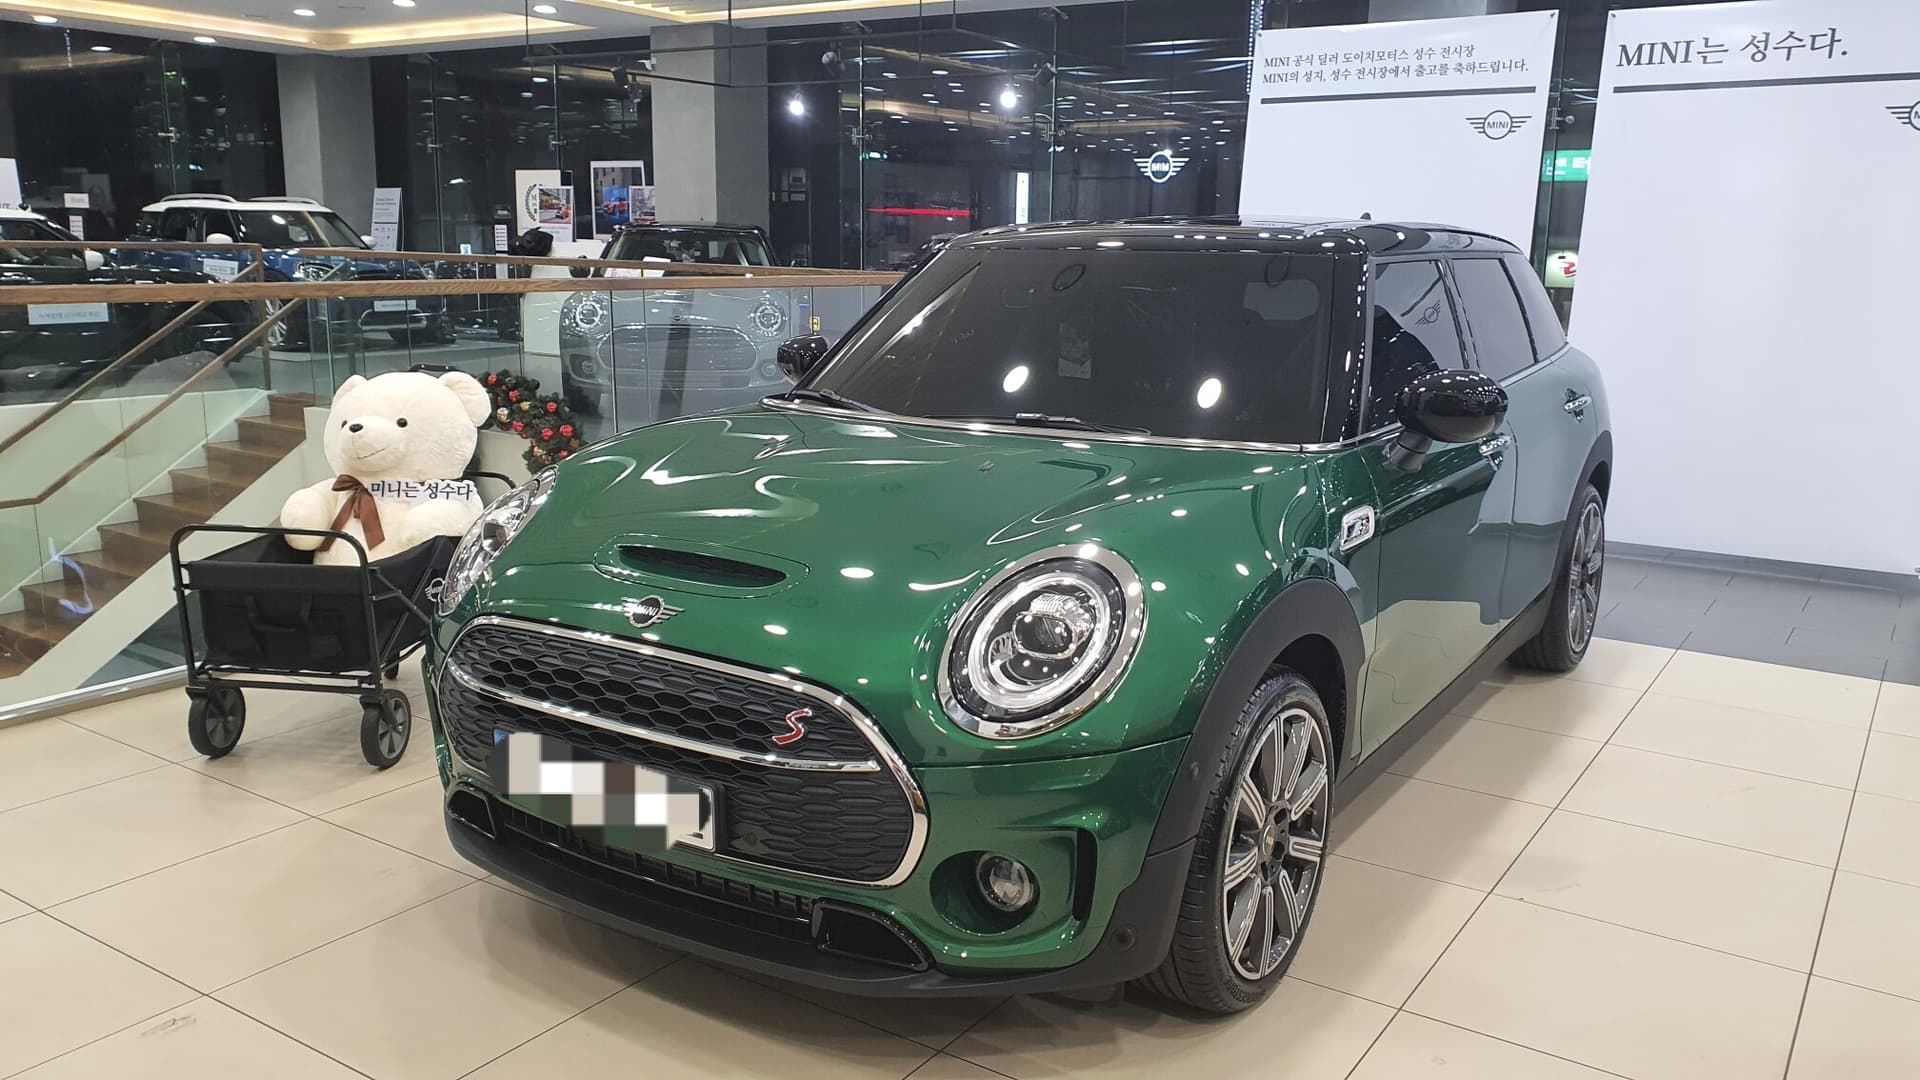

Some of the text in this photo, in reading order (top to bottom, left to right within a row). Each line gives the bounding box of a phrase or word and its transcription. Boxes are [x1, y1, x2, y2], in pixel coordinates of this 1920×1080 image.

[1264, 44, 1475, 68] MINI 공식 딜러 도이치모터스 성수 전시장
[1616, 27, 1848, 67] MINI는 성수다.
[1262, 58, 1529, 84] MINI의 성지, 성수 전시장에서 출고를 축하드립니다.
[1486, 121, 1509, 129] MINI
[371, 480, 473, 501] 미니는 성수다
[771, 707, 812, 745] S
